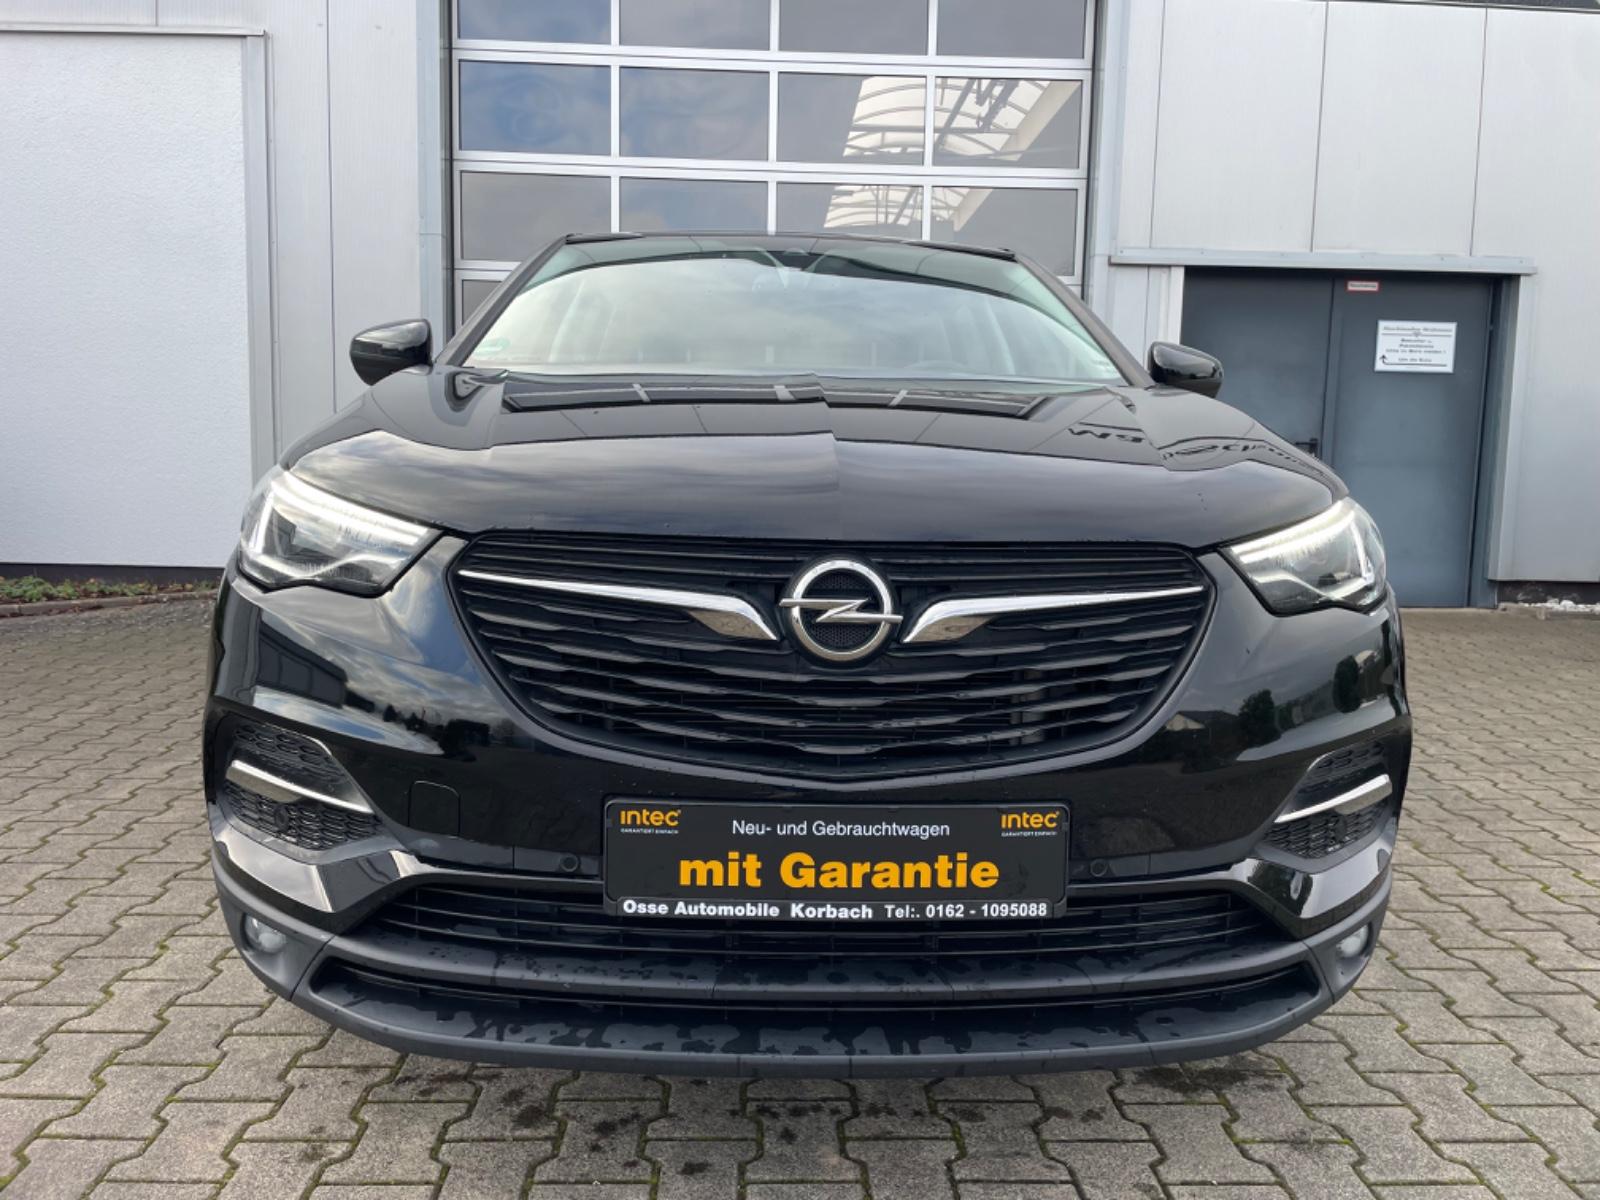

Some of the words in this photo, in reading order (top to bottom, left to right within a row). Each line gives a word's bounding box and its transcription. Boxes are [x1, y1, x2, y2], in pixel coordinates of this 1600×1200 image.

[620, 809, 680, 827] intec
[1001, 812, 1059, 829] intec
[732, 820, 772, 836] Neu-
[776, 820, 808, 837] und
[812, 820, 951, 840] Gebrauchtwagen
[679, 851, 762, 888] mit
[779, 851, 1000, 889] Garantie
[623, 899, 669, 915] Osse
[675, 901, 780, 918] Automobile
[790, 903, 873, 919] Korbach
[925, 904, 965, 918] 0162
[981, 903, 1047, 917] 1095088
